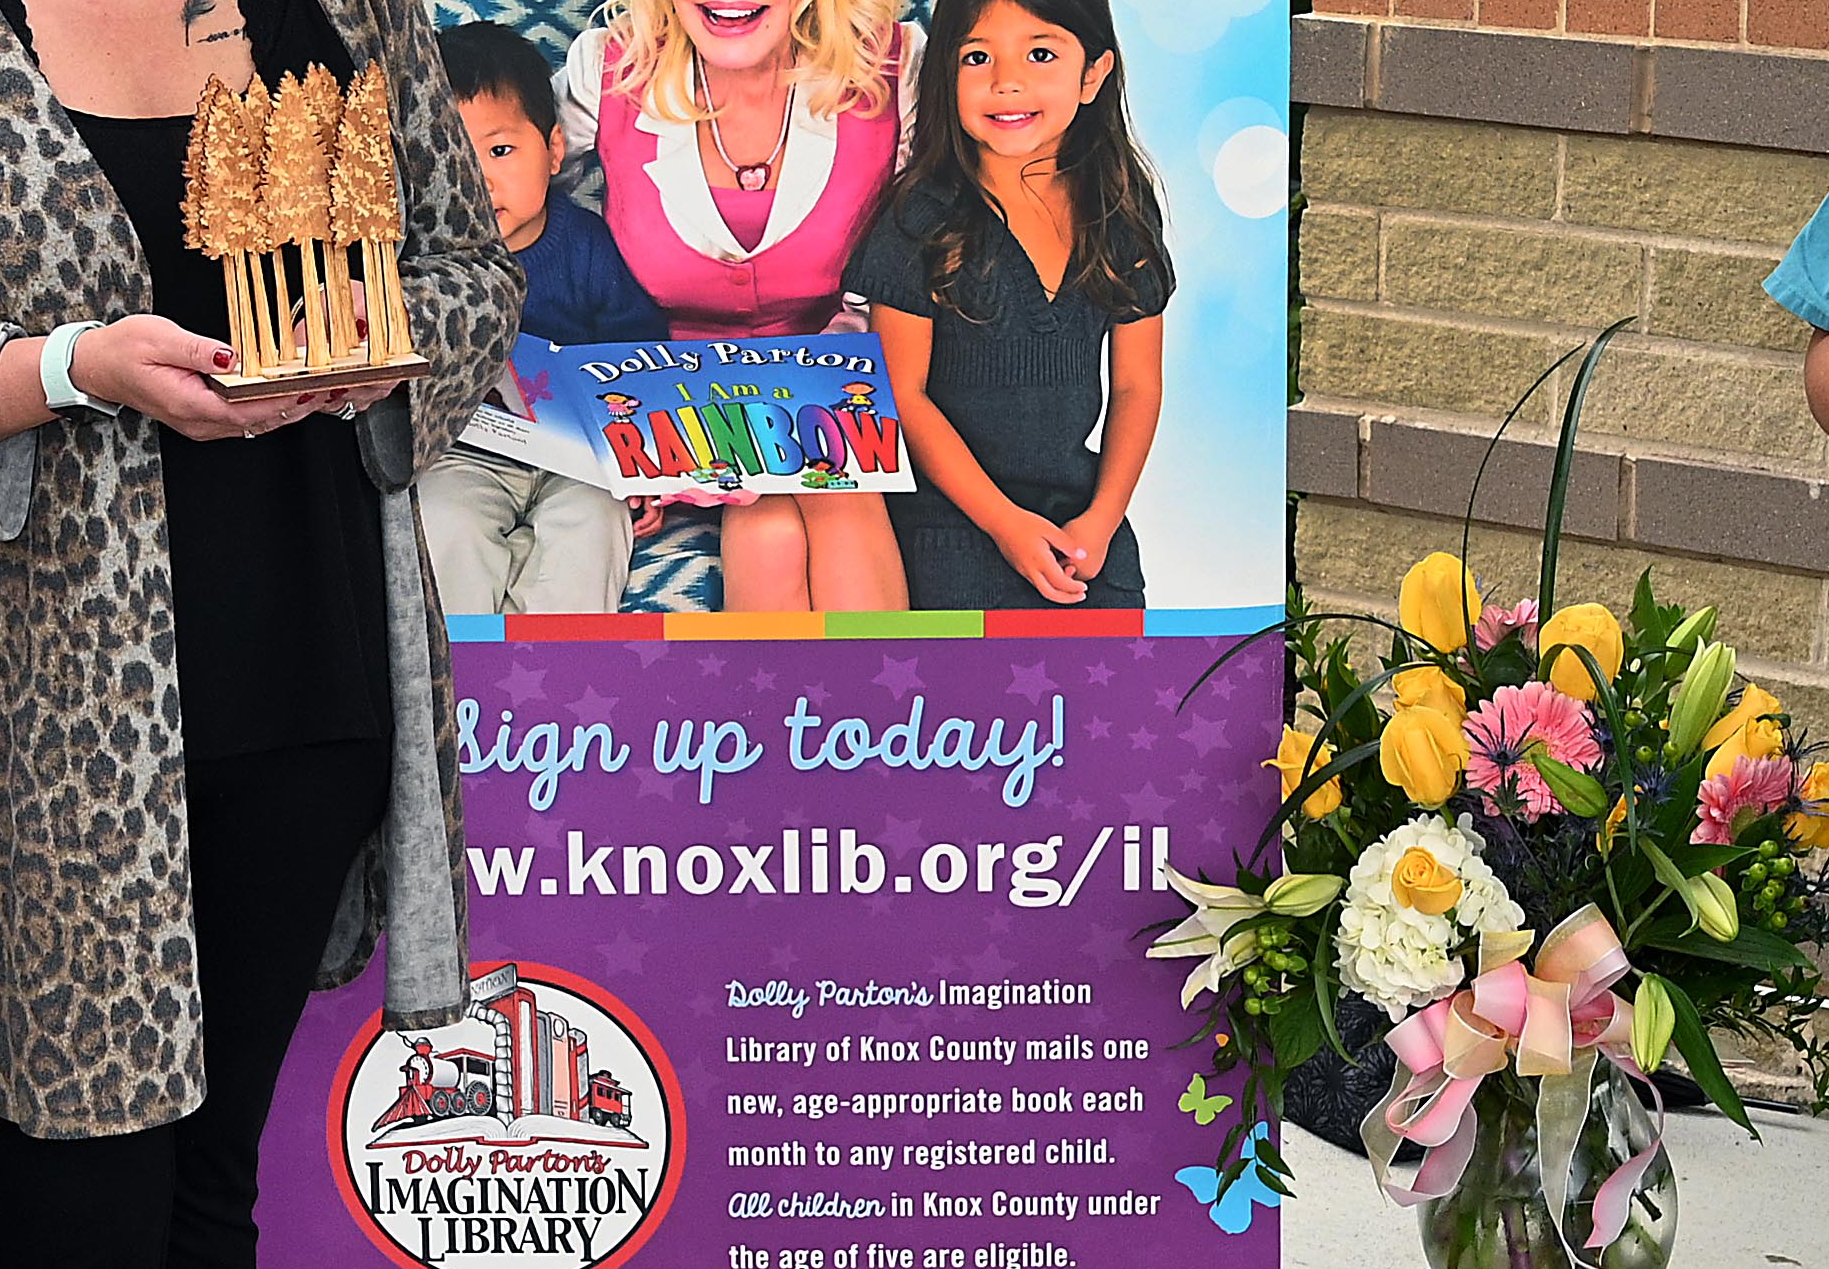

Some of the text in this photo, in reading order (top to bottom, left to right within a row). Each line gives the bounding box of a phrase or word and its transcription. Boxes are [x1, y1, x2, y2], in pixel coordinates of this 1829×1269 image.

[578, 342, 876, 384] Dolly Parton
[675, 381, 794, 403] I Am a
[602, 402, 901, 479] RAINBOW
[653, 720, 763, 804] up
[784, 694, 1064, 807] today!
[466, 826, 1169, 907] w.knoxlib.org/il
[726, 979, 1090, 1018] Dolly Parton's Imagination
[727, 1035, 1148, 1066] Library of Knox County mails one
[728, 1087, 1142, 1118] new, age-appropriate book each
[402, 1146, 611, 1179] Dolly Parton's
[729, 1139, 1114, 1170] month to any registered child.
[365, 1162, 649, 1216] IMAGINATION
[729, 1191, 1160, 1220] All children in Knox County under
[418, 1216, 602, 1263] LIBRARY
[729, 1245, 768, 1268] the
[835, 1244, 858, 1268] of
[867, 1244, 913, 1268] five
[924, 1249, 964, 1267] are
